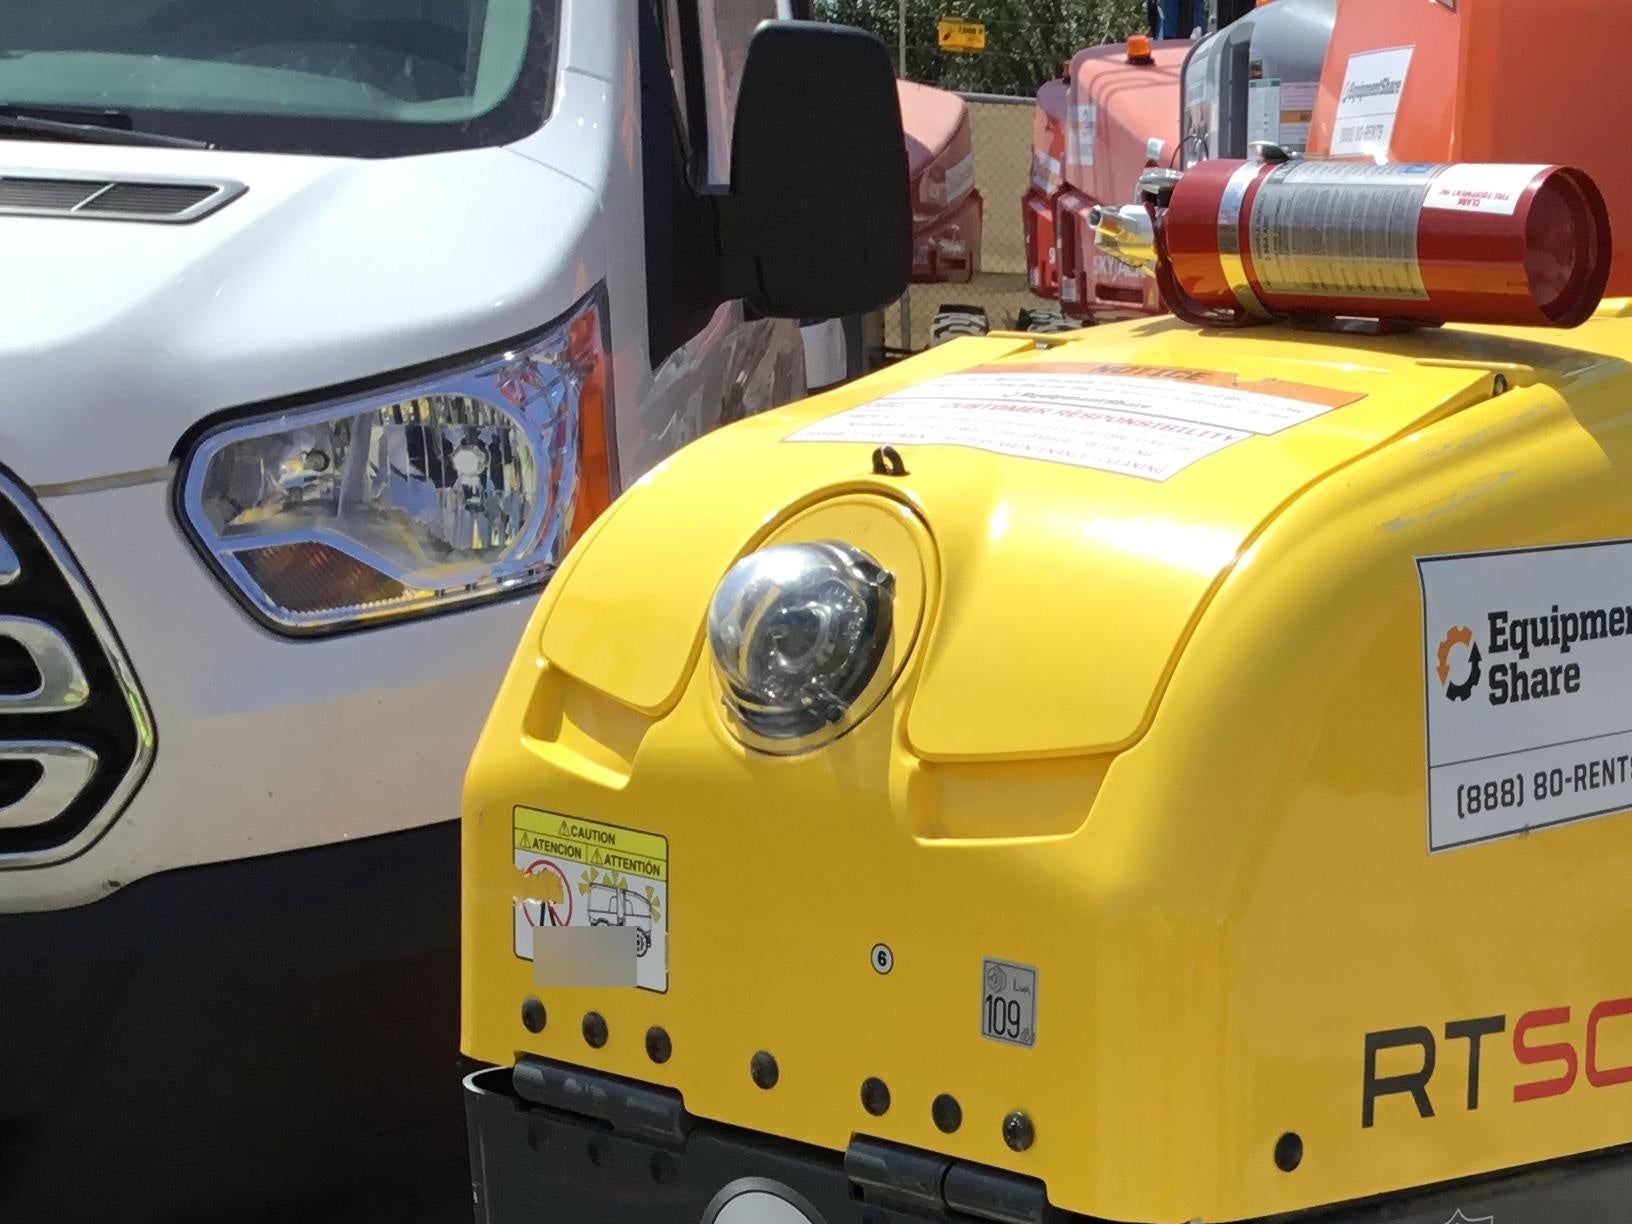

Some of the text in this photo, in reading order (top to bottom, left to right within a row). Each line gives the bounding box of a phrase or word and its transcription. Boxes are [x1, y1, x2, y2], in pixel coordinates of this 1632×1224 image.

[1090, 364, 1214, 381] NOTICE
[941, 402, 1053, 416] CUSTOMER
[1054, 408, 1240, 442] RESPONSIBILITY
[1488, 661, 1581, 706] Share
[1456, 773, 1524, 819] (888)
[532, 837, 582, 860] ATENCION
[570, 824, 616, 846] CAUTION
[877, 950, 887, 967] 6
[985, 993, 1021, 1039] 109
